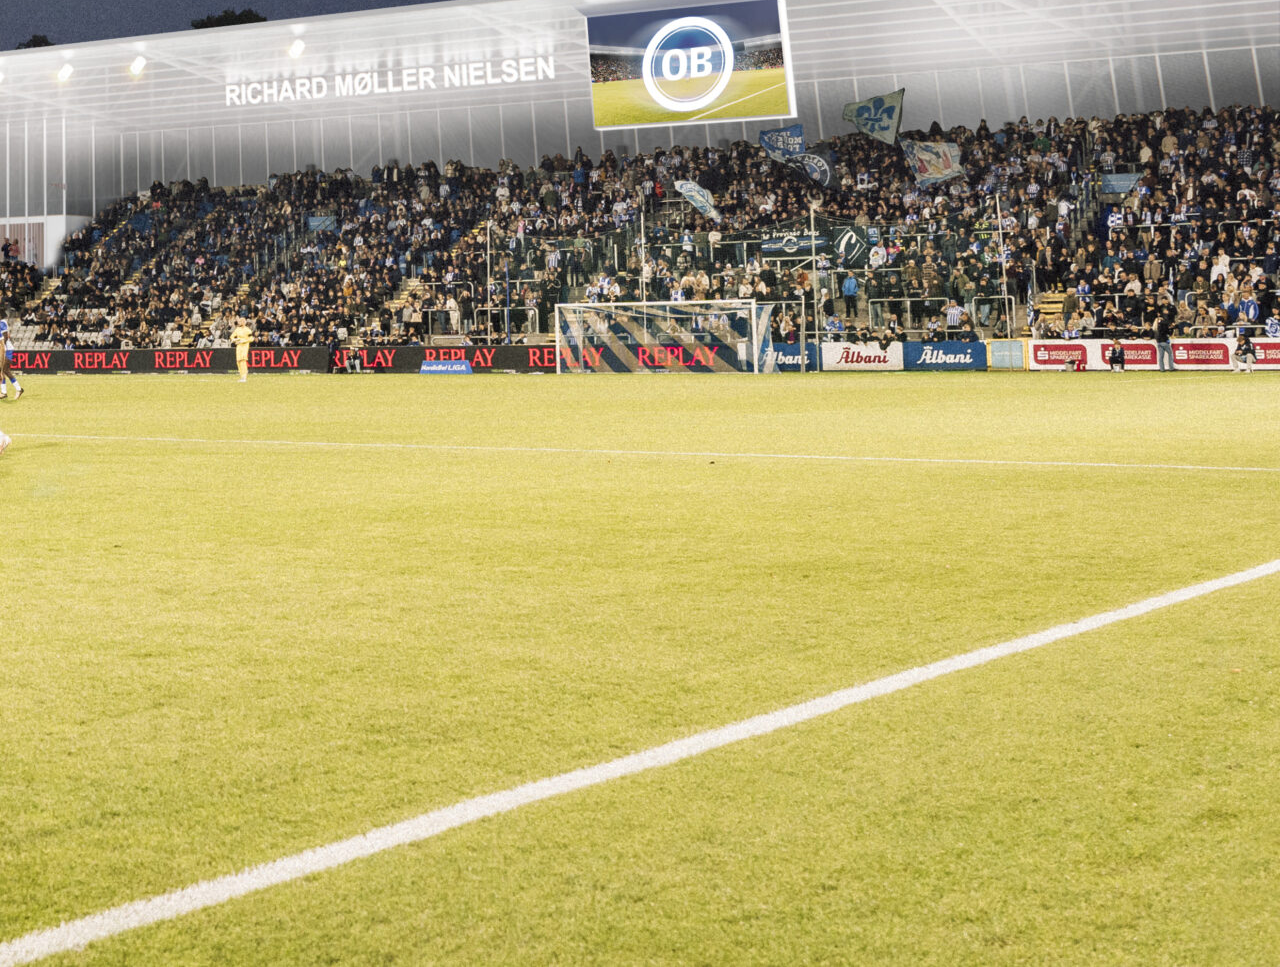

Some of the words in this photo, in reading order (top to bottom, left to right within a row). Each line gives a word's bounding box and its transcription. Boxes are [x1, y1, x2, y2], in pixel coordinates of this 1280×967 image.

[662, 46, 713, 81] OB
[225, 76, 327, 106] RICHARD
[334, 67, 436, 97] MØLLER
[444, 56, 555, 88] NIELSEN
[10, 352, 51, 369] EPLAY
[74, 352, 130, 369] REPLAY
[155, 350, 214, 369] REPLAY
[246, 349, 301, 368] EPLAY
[334, 349, 396, 367] RELAY
[637, 346, 719, 367] REPLAY
